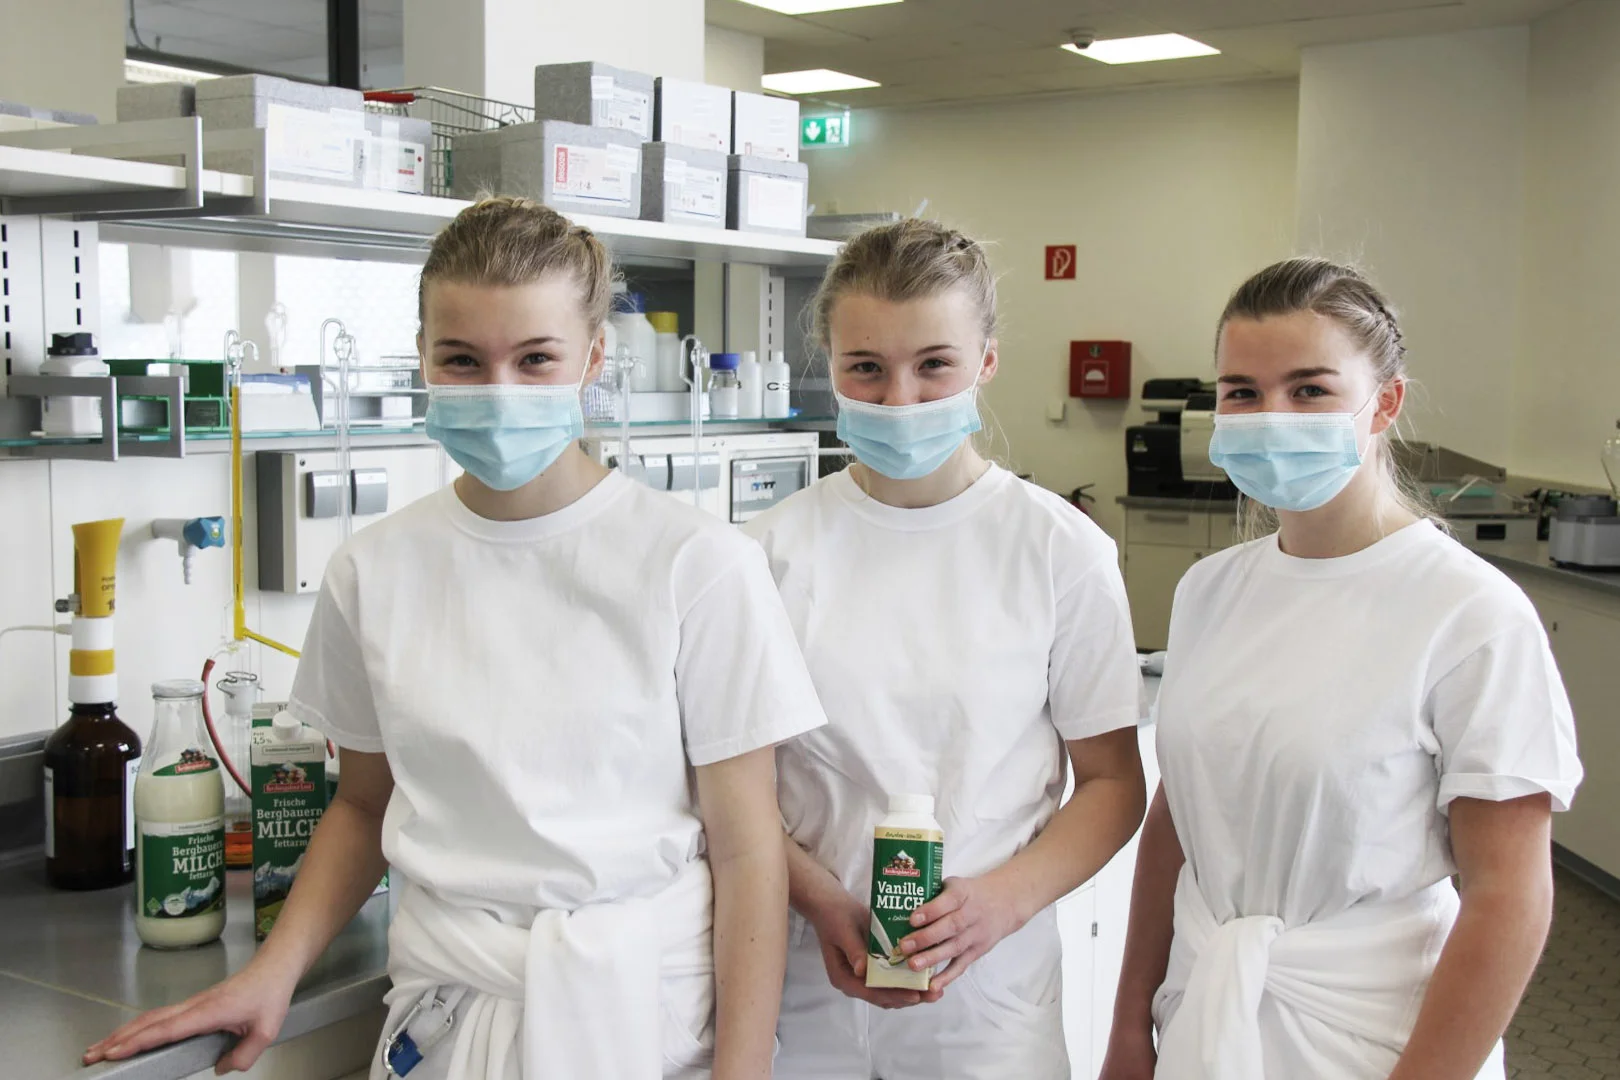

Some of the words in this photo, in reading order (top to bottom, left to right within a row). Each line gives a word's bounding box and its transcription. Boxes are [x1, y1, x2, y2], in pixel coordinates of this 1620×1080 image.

[273, 798, 306, 808] Frische
[256, 808, 323, 820] Bergbauern
[188, 834, 215, 845] Frische
[172, 850, 224, 874] MILCH
[877, 881, 925, 896] Vanille
[876, 894, 925, 911] MILCH
